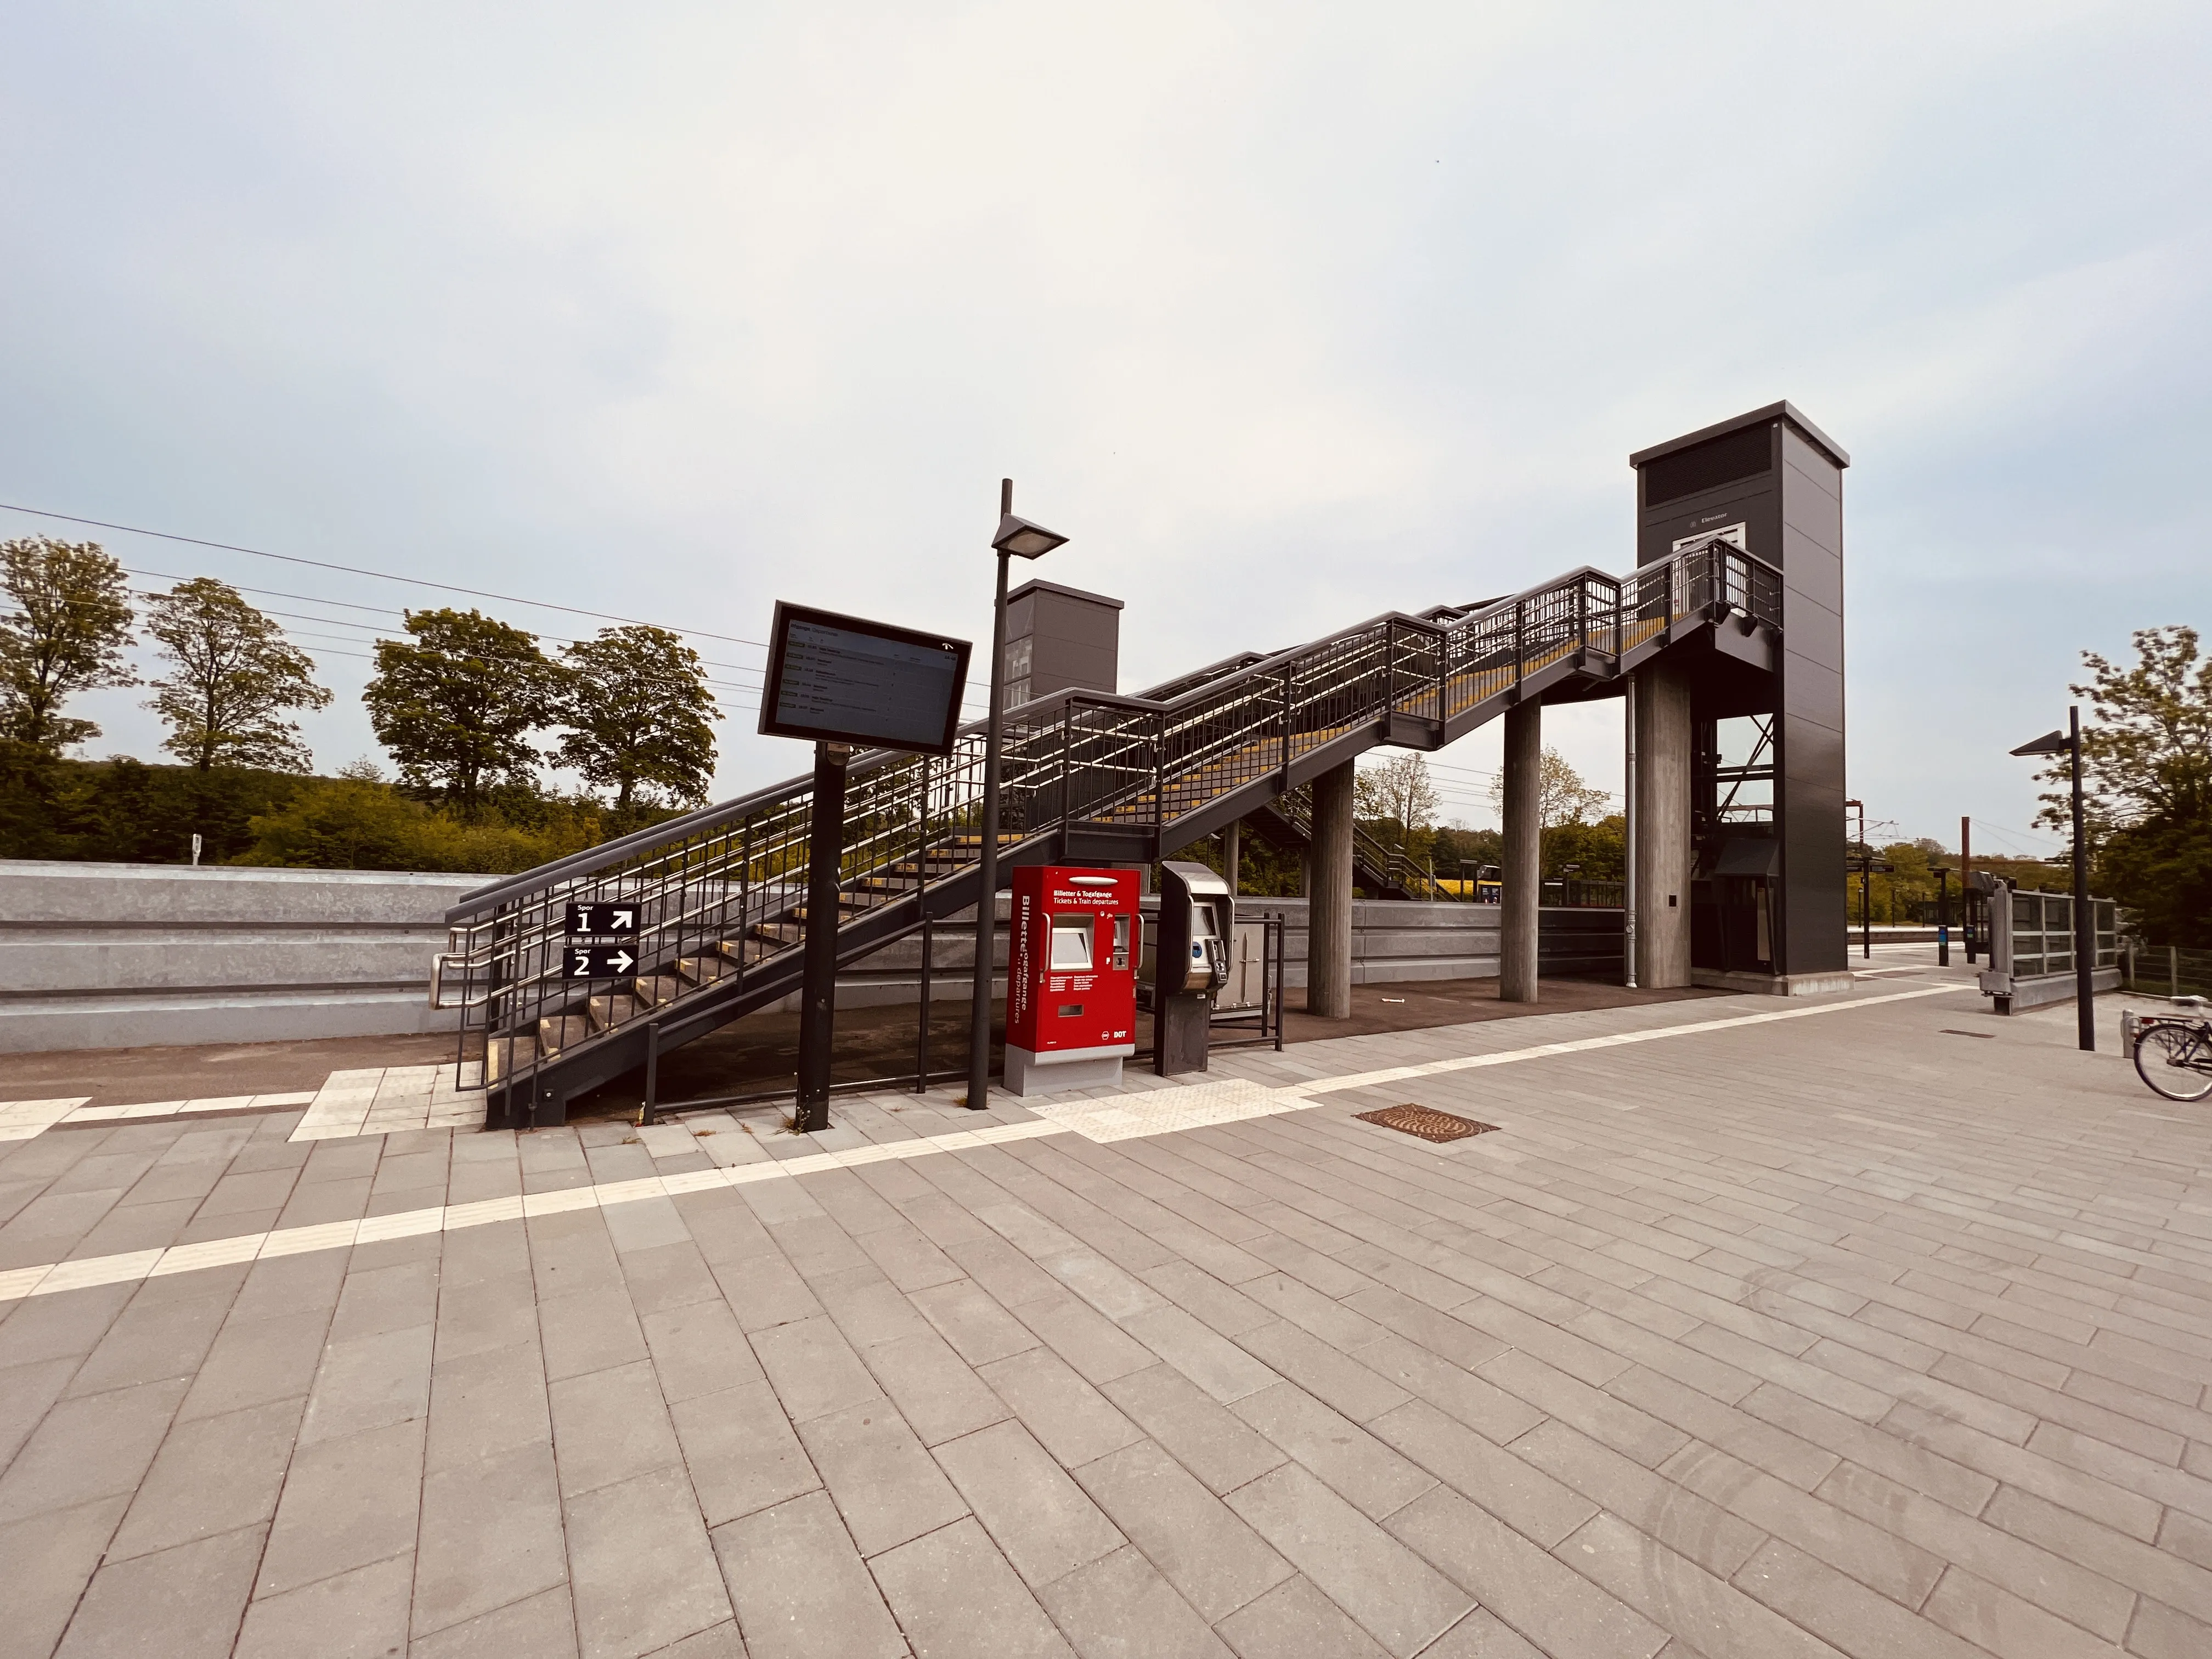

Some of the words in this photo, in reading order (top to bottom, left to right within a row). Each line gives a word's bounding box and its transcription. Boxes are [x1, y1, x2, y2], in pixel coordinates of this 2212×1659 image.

[1701, 512, 1728, 523] Elevator
[1082, 890, 1112, 899] Togafgange
[577, 913, 591, 932] 1
[1020, 895, 1030, 957] Billette
[574, 956, 590, 976] 2
[1021, 952, 1029, 1011] ogafgange
[1114, 1030, 1127, 1039] DOT
